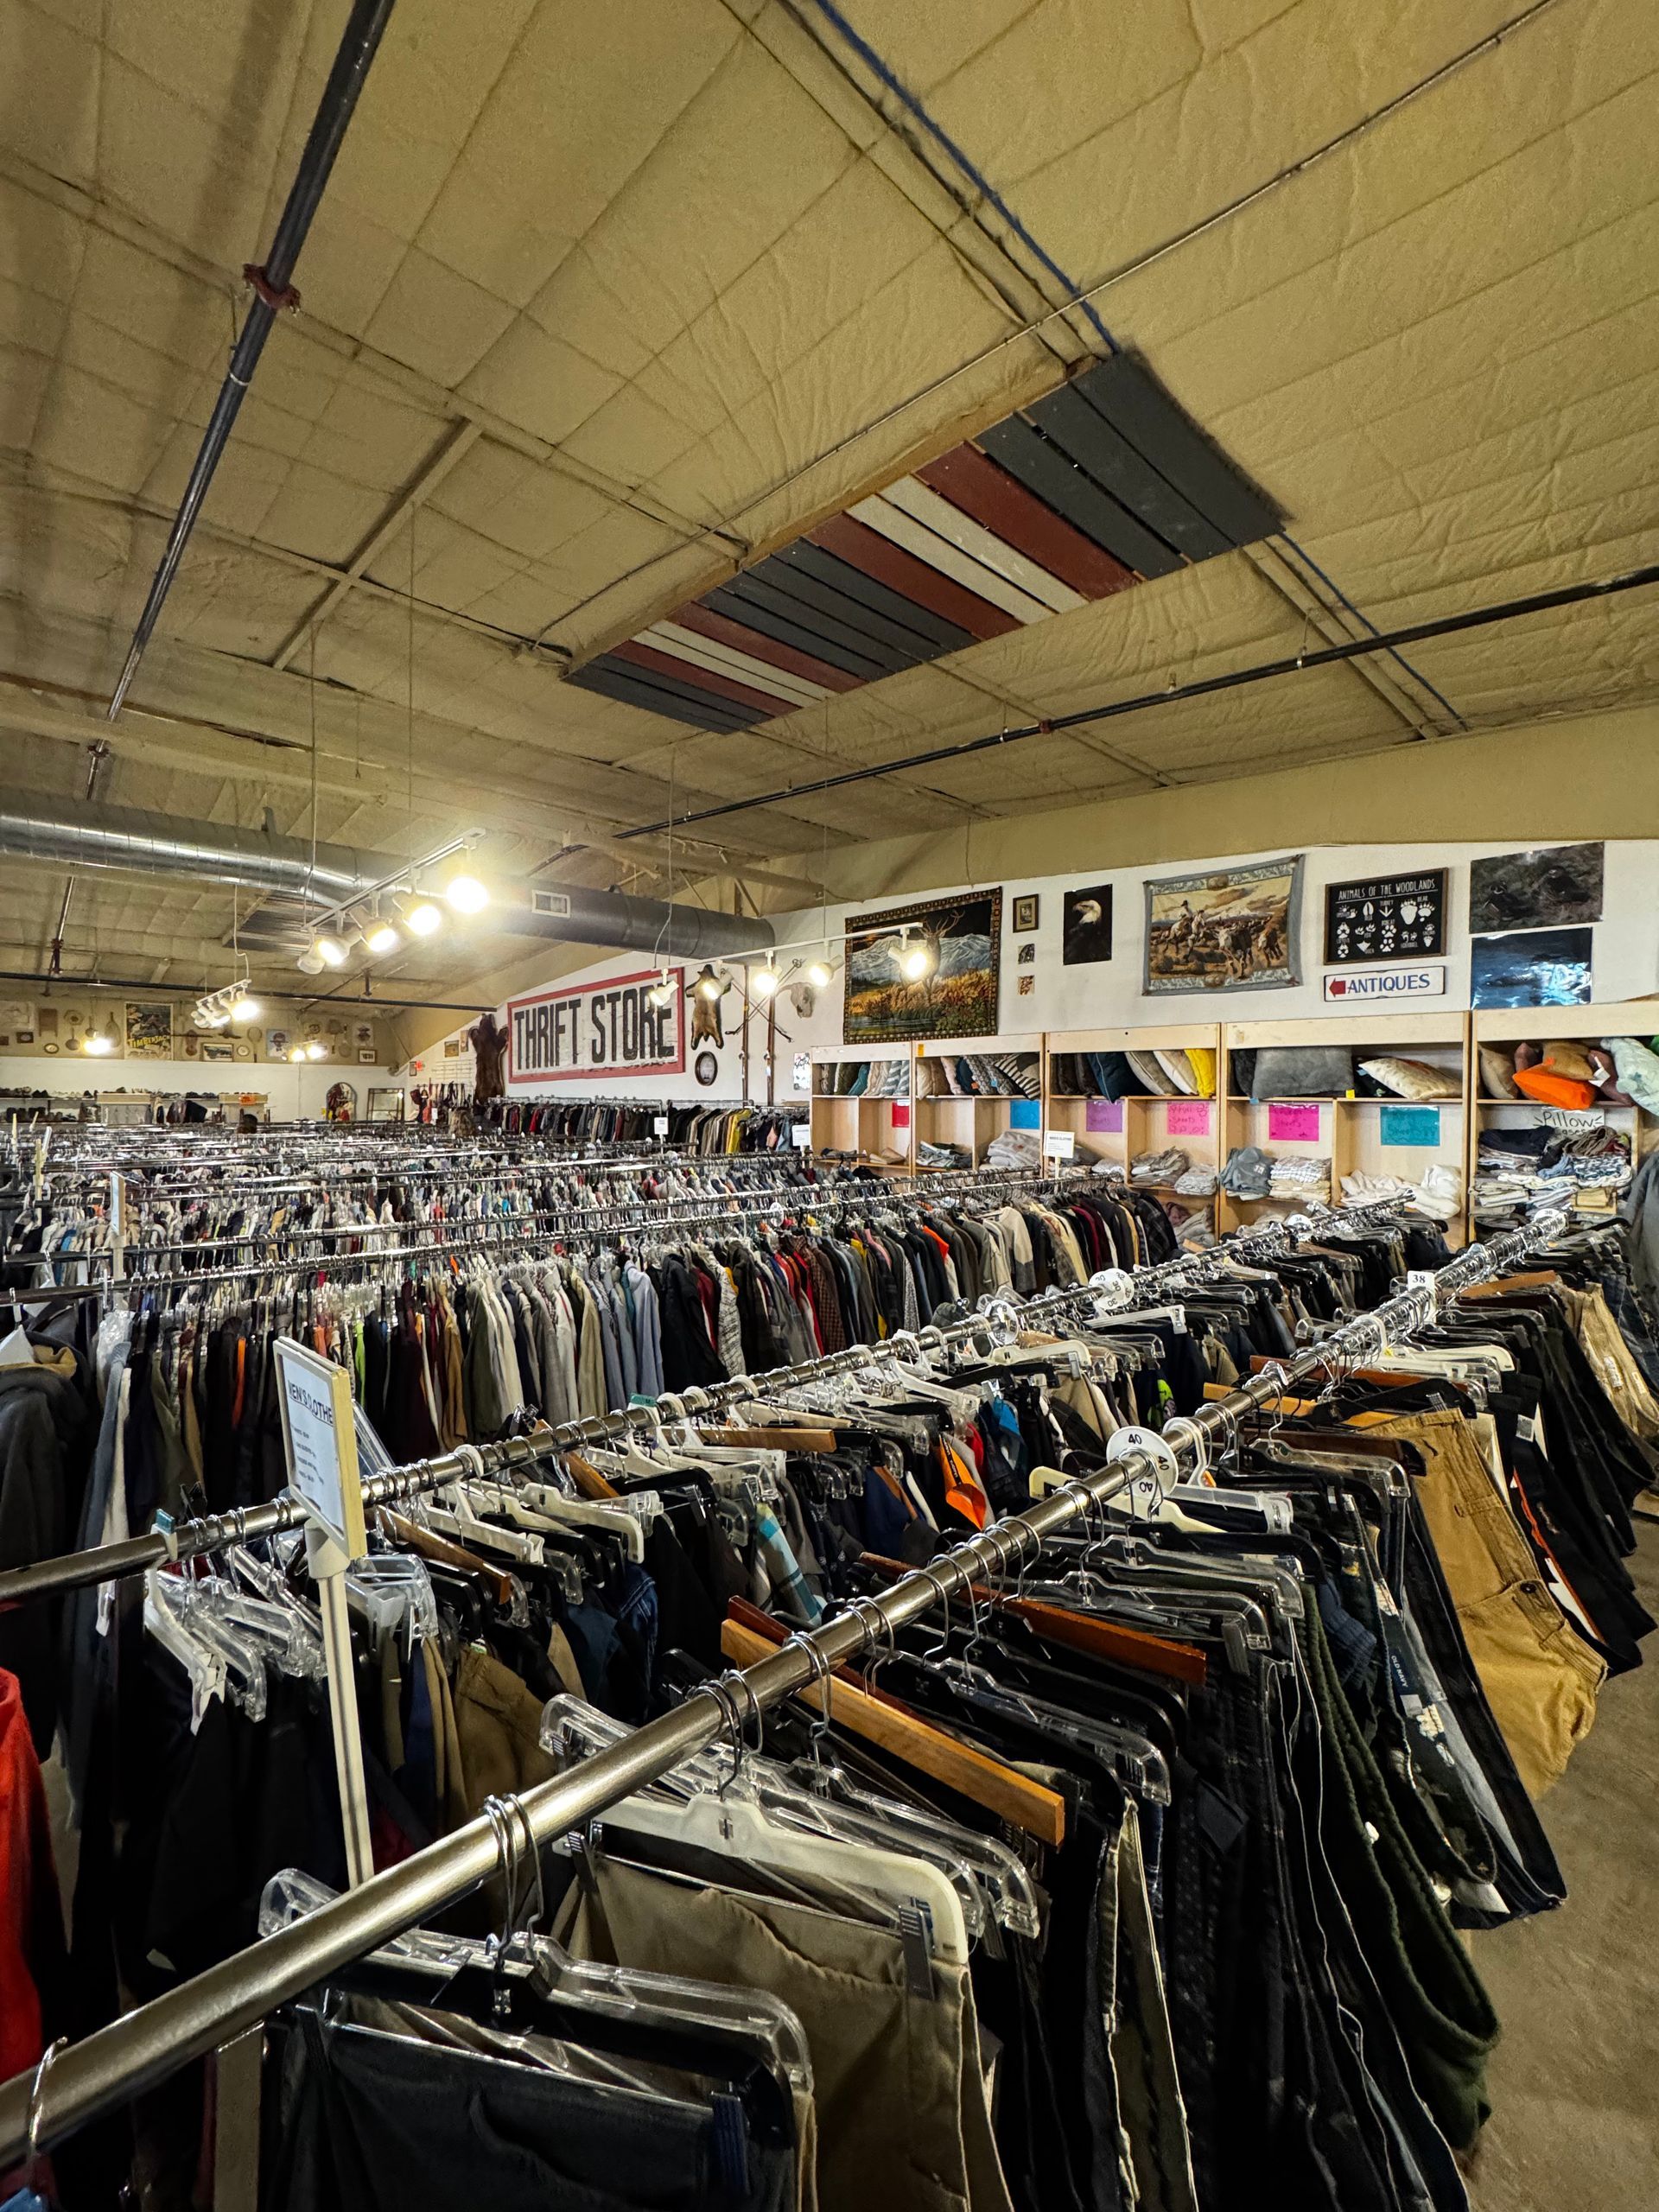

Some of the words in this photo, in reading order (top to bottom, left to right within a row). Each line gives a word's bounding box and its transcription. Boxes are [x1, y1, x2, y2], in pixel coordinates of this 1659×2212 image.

[1338, 887, 1365, 900] ANIMALS
[1369, 886, 1376, 897] OF
[1381, 883, 1392, 895] THE
[1395, 879, 1435, 893] WOODLANDS
[1347, 974, 1431, 995] ANTIQUES
[514, 998, 582, 1071] THRIFT
[591, 981, 675, 1064] STORE
[1542, 1110, 1594, 1128] Pillow
[1112, 1280, 1122, 1292] 30
[1412, 1274, 1426, 1284] 38
[1107, 1298, 1118, 1307] 30
[1128, 1433, 1142, 1445] 40
[1158, 1455, 1170, 1471] 40
[1139, 1481, 1154, 1493] 40
[1390, 1655, 1401, 1669] OLD
[1395, 1669, 1408, 1688] NAVY
